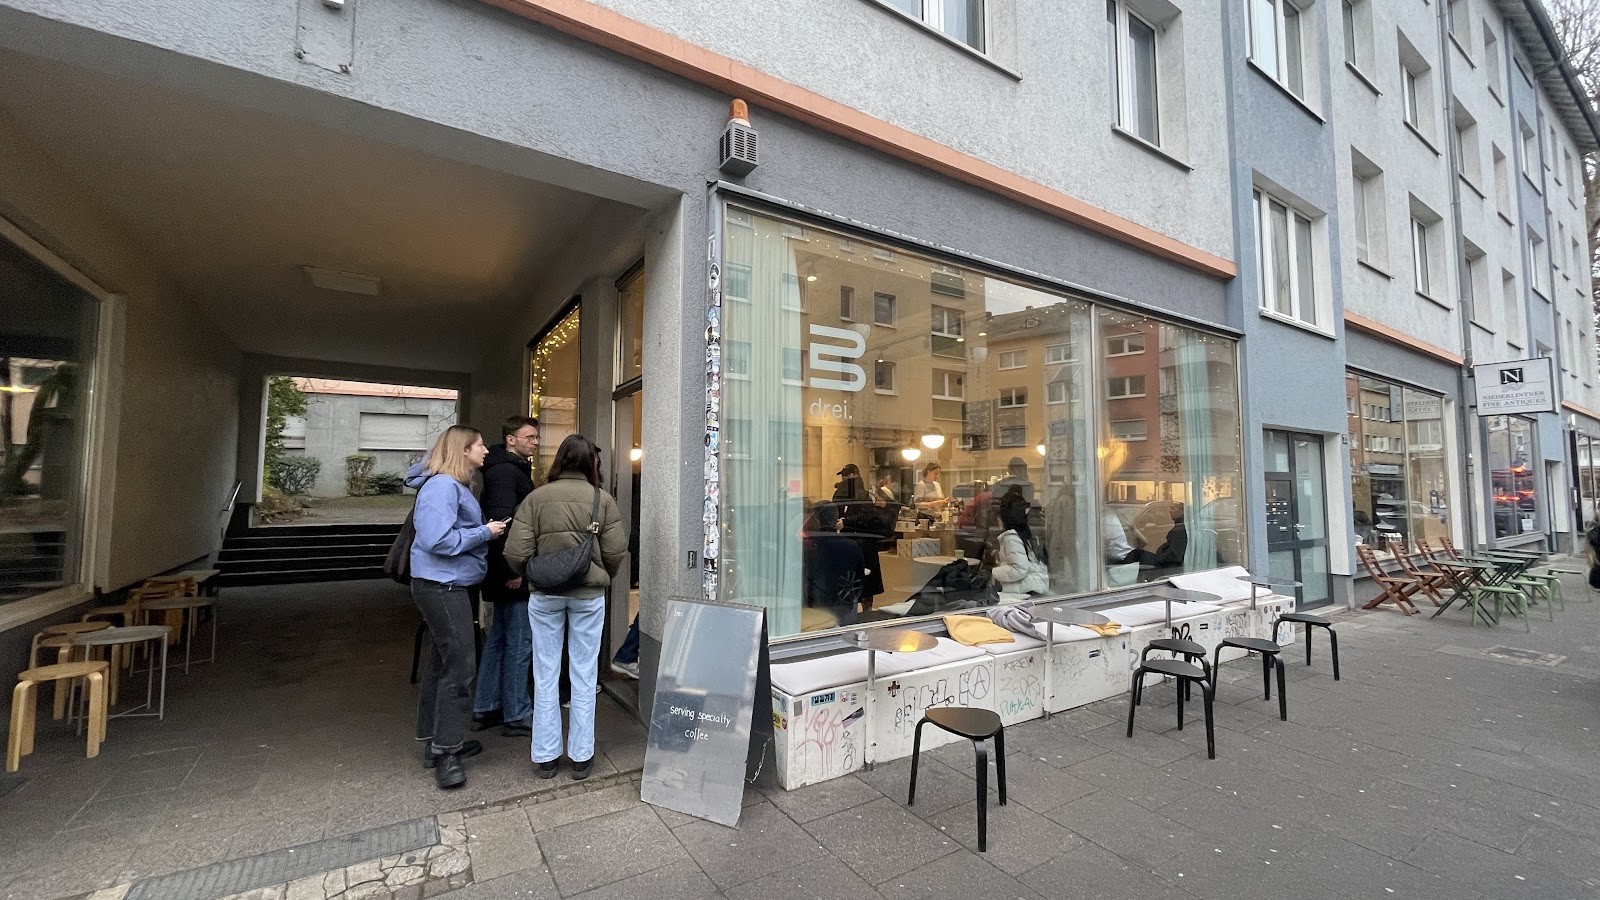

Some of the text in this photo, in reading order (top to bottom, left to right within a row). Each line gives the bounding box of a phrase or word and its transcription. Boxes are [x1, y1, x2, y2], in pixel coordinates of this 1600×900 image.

[1502, 369, 1521, 383] N
[810, 398, 853, 419] drei.
[670, 705, 731, 728] serving specialty
[684, 727, 709, 741] coffee
